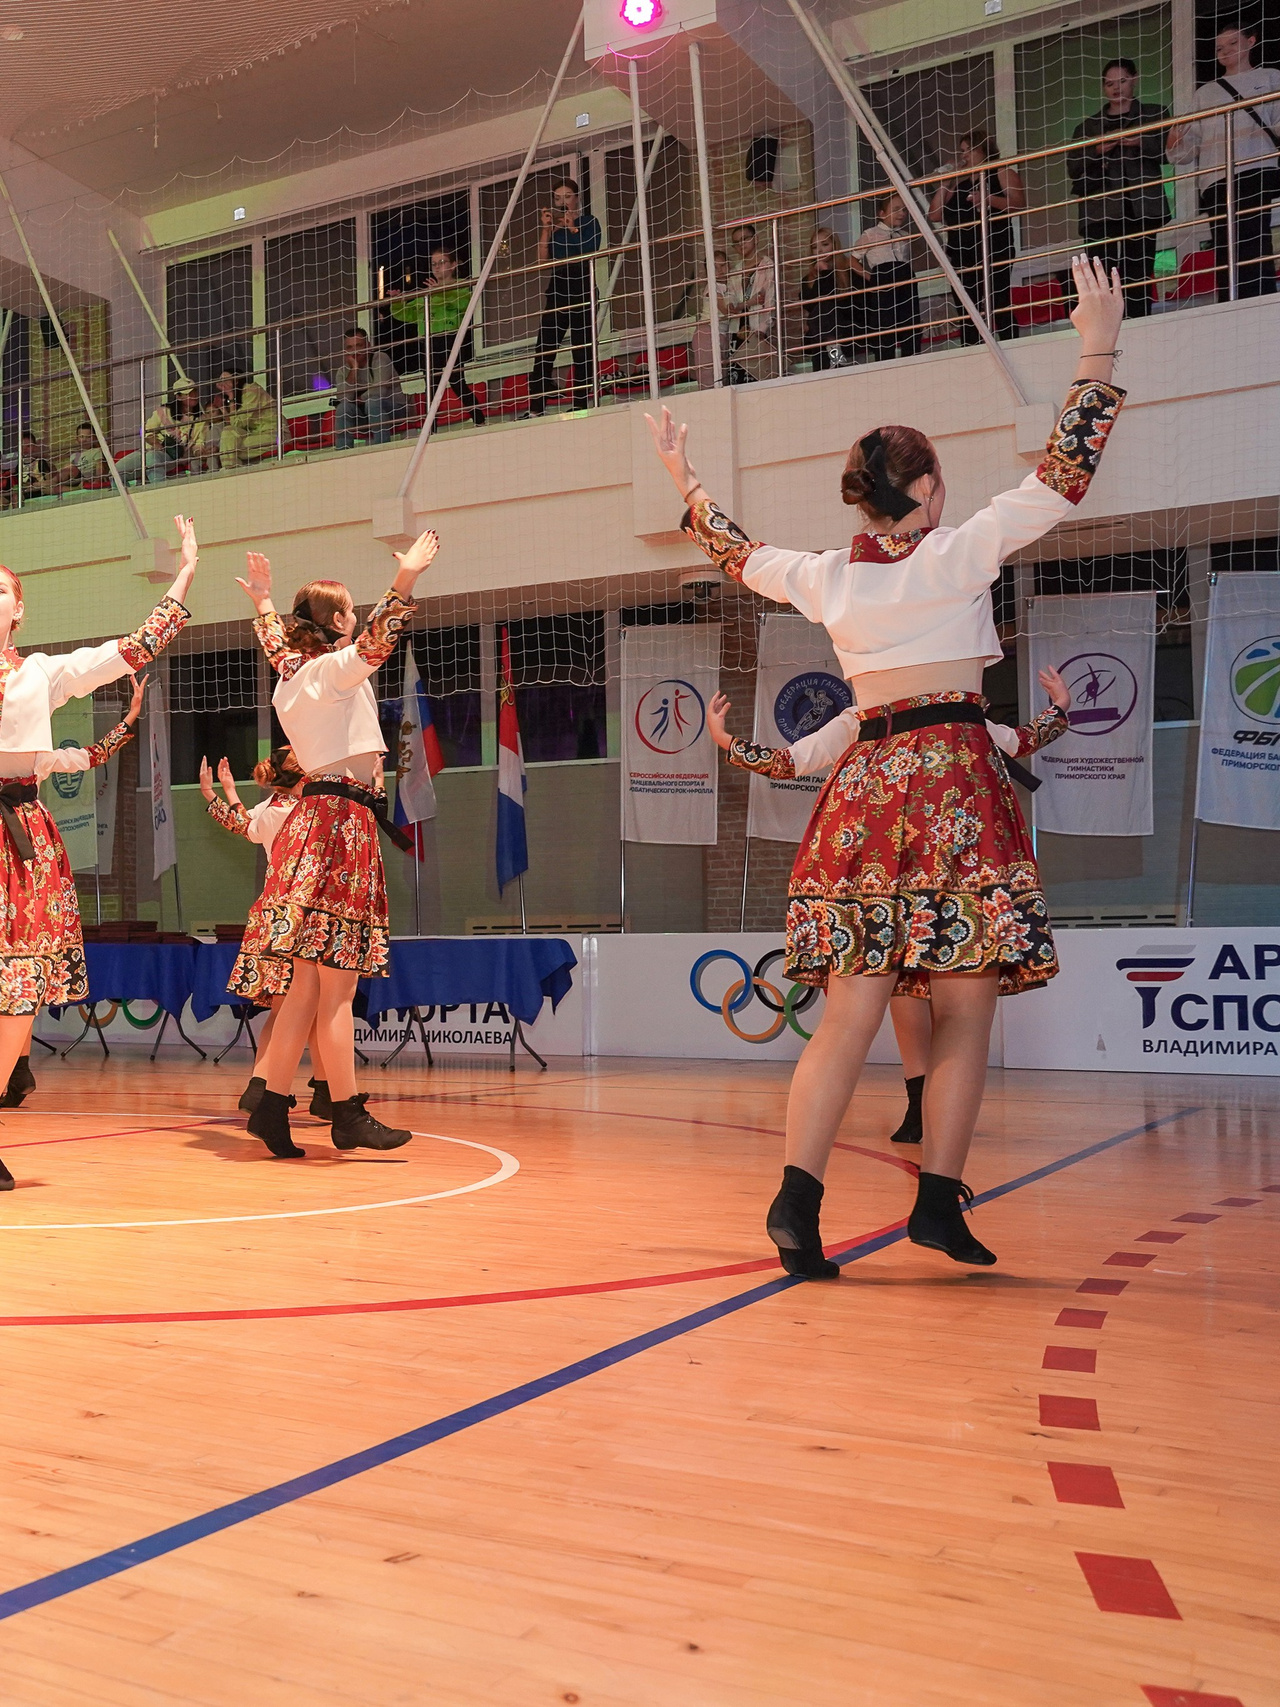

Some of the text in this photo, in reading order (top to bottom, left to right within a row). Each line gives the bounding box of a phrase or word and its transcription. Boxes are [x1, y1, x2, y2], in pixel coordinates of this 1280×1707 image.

[779, 678, 851, 711] ФЕДЕРАЦИЯ ГАНДБОЛ
[1080, 756, 1144, 764] ХУДОЖЕСТВЕННОЙ
[1211, 747, 1266, 761] ФЕДЕРАЦИЯ
[675, 772, 709, 780] ФЕДЕРАЦИЯ
[1142, 1039, 1279, 1058] ВЛАДИМИРА
